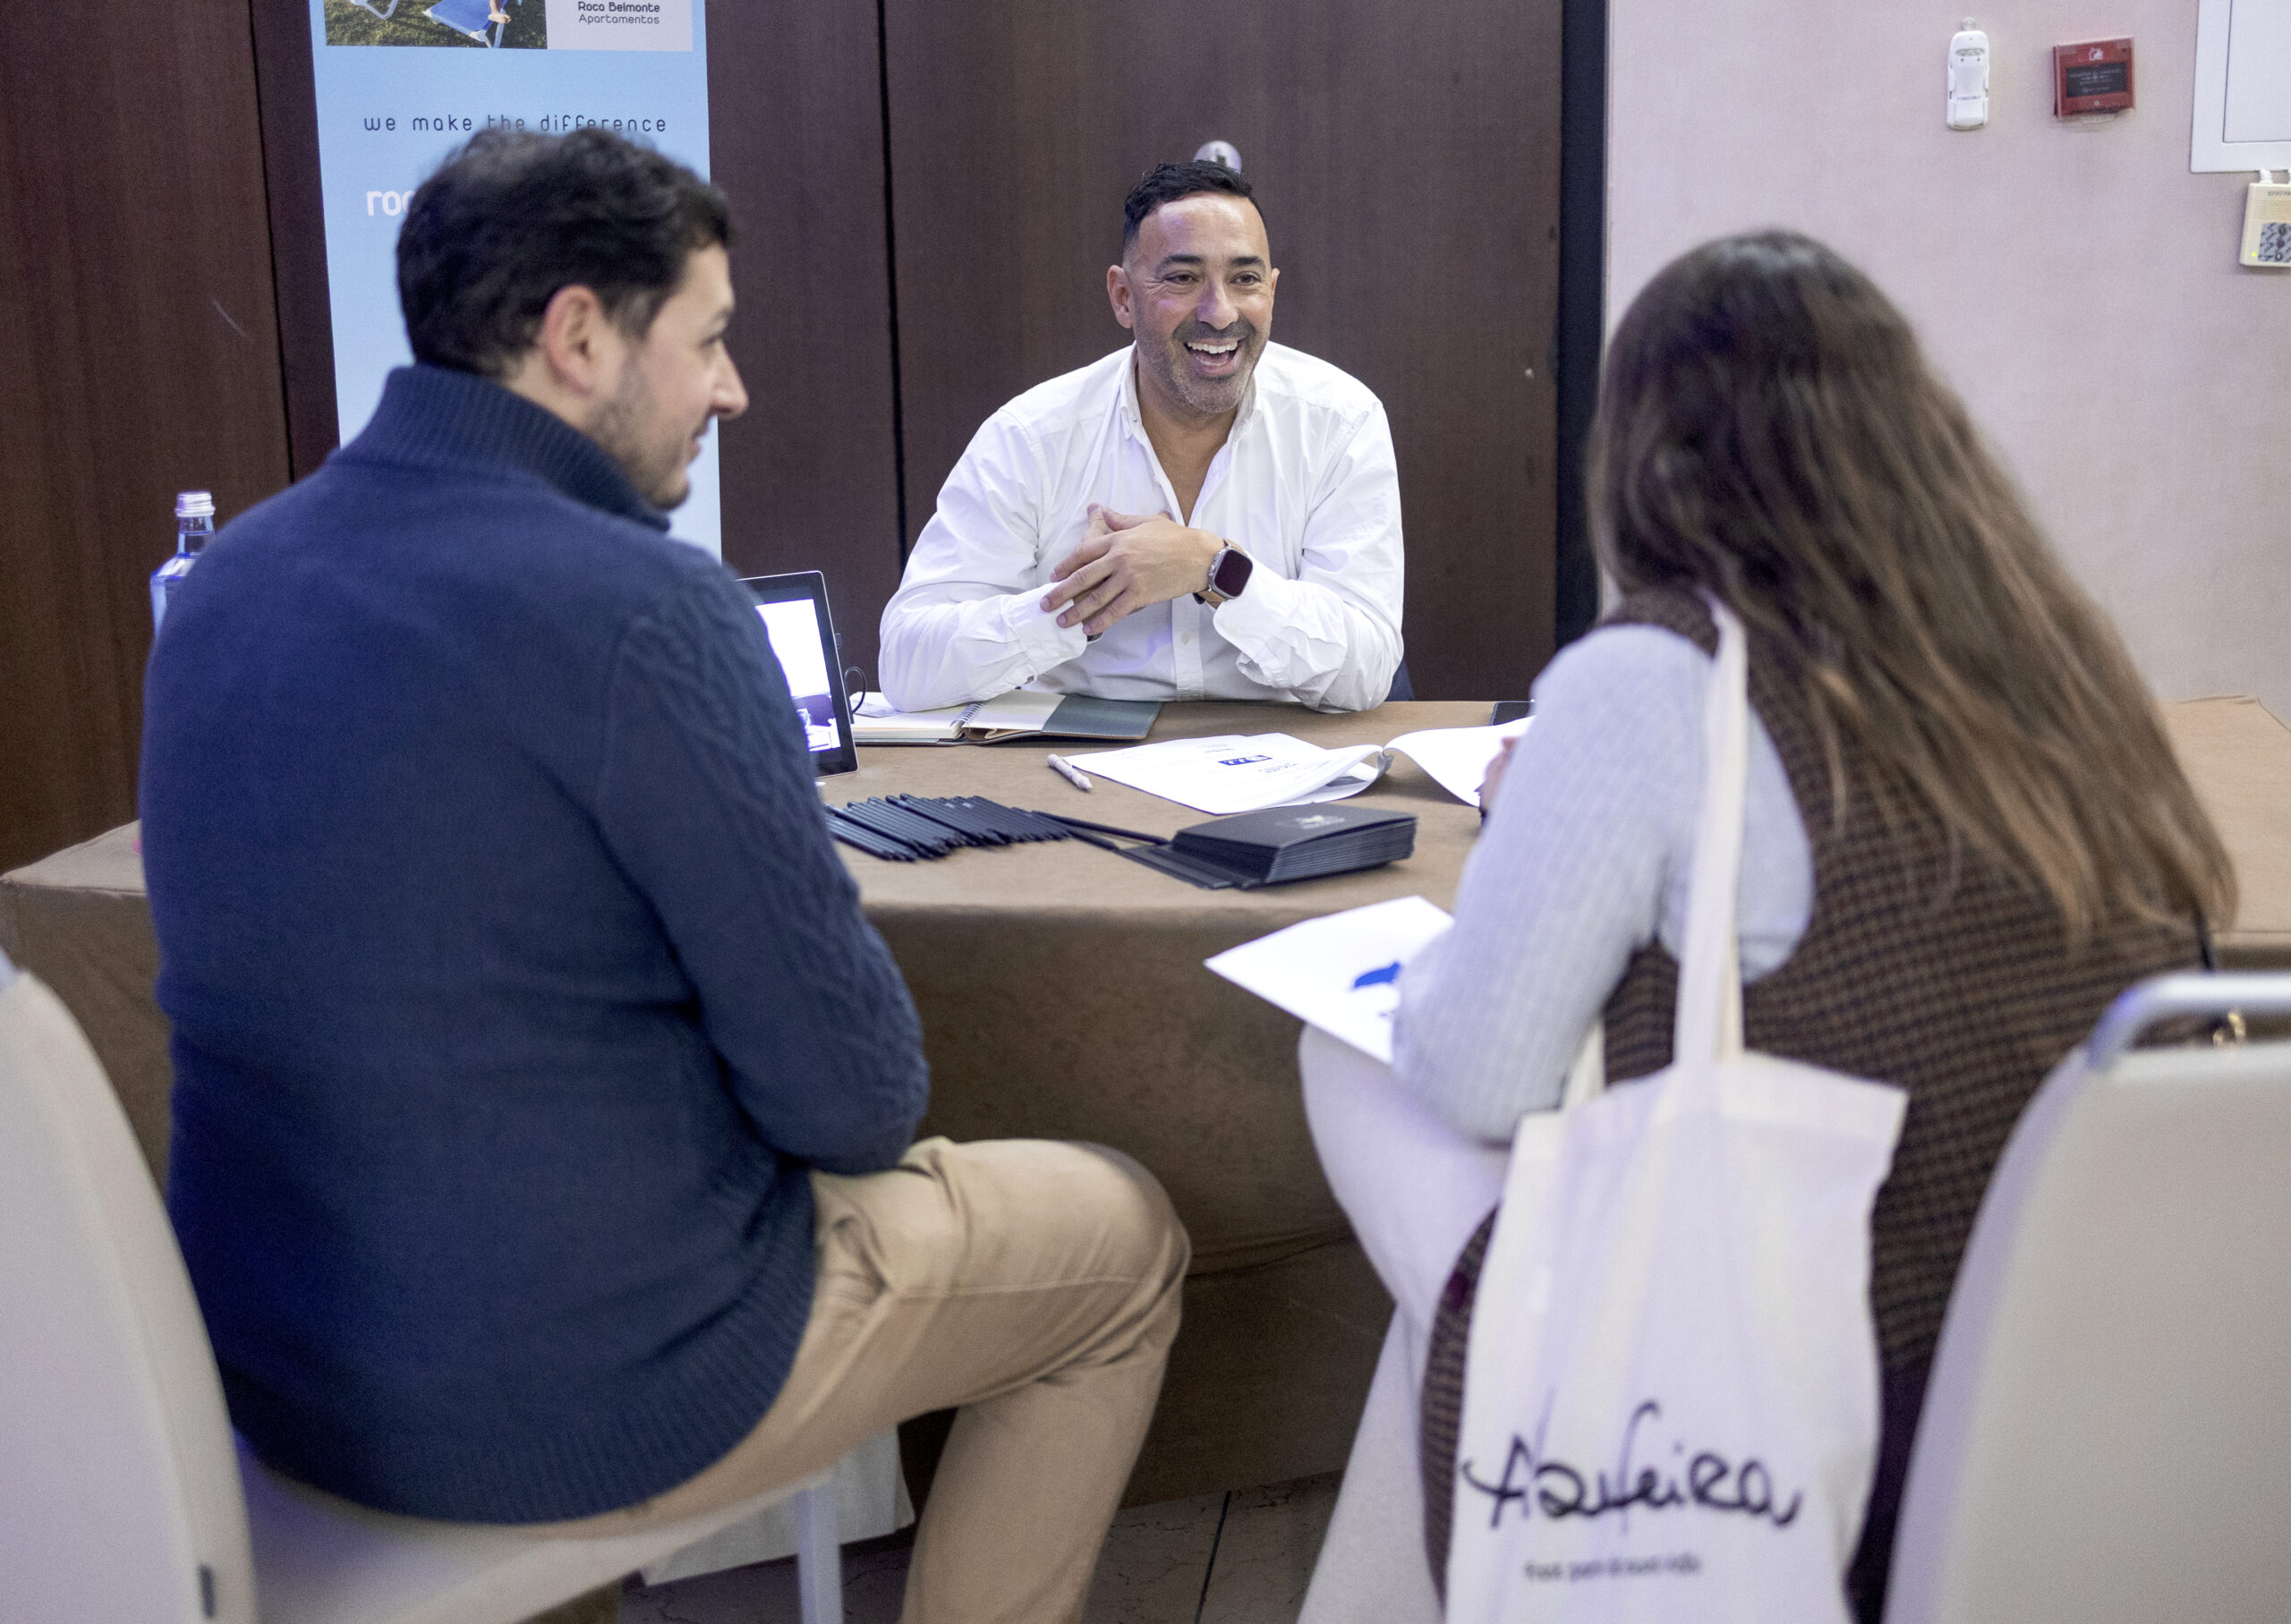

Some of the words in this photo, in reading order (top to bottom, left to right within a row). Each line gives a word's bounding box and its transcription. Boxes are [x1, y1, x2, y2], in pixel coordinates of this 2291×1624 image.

[578, 1, 605, 12] Roca
[609, 2, 660, 13] Belmonte
[578, 13, 660, 25] Apartamentos
[363, 117, 396, 132] we
[413, 114, 473, 132] make
[487, 114, 525, 131] the
[540, 114, 666, 132] difference
